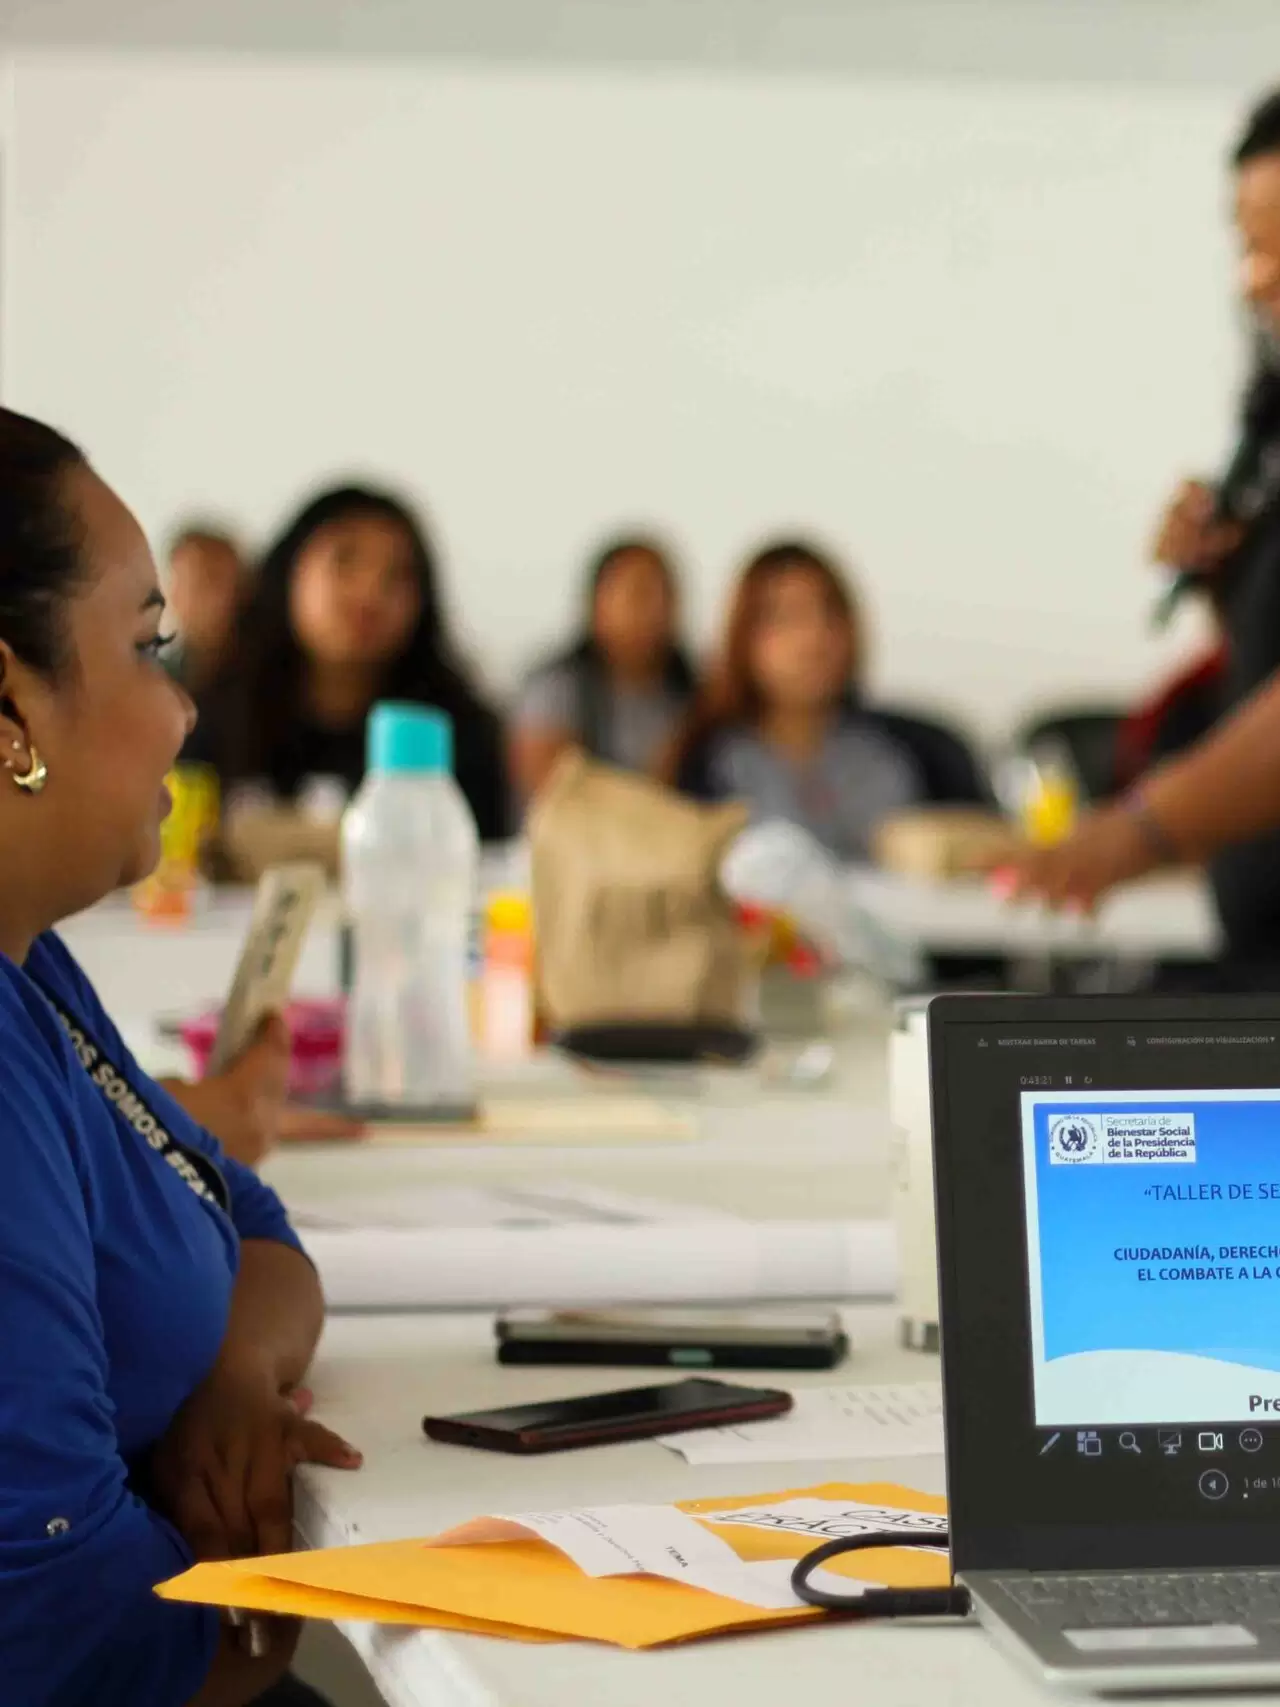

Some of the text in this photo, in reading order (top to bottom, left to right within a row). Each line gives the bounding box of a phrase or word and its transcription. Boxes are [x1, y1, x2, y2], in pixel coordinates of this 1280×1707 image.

[92, 1063, 169, 1149] SOMOS
[1106, 1115, 1171, 1127] Secretaría de
[1107, 1126, 1190, 1137] Bienestar Social
[1108, 1137, 1195, 1147] de la Presidencia
[1108, 1147, 1187, 1159] de la República
[1228, 1183, 1252, 1199] DE
[1113, 1245, 1215, 1262] CIUDADANÍA,
[1137, 1268, 1155, 1281] EL
[1159, 1266, 1234, 1281] COMBATE
[1238, 1266, 1249, 1279] A
[1253, 1266, 1272, 1279] LA
[1243, 1476, 1249, 1488] 1
[1253, 1476, 1267, 1488] de
[665, 1545, 689, 1568] TEMA
